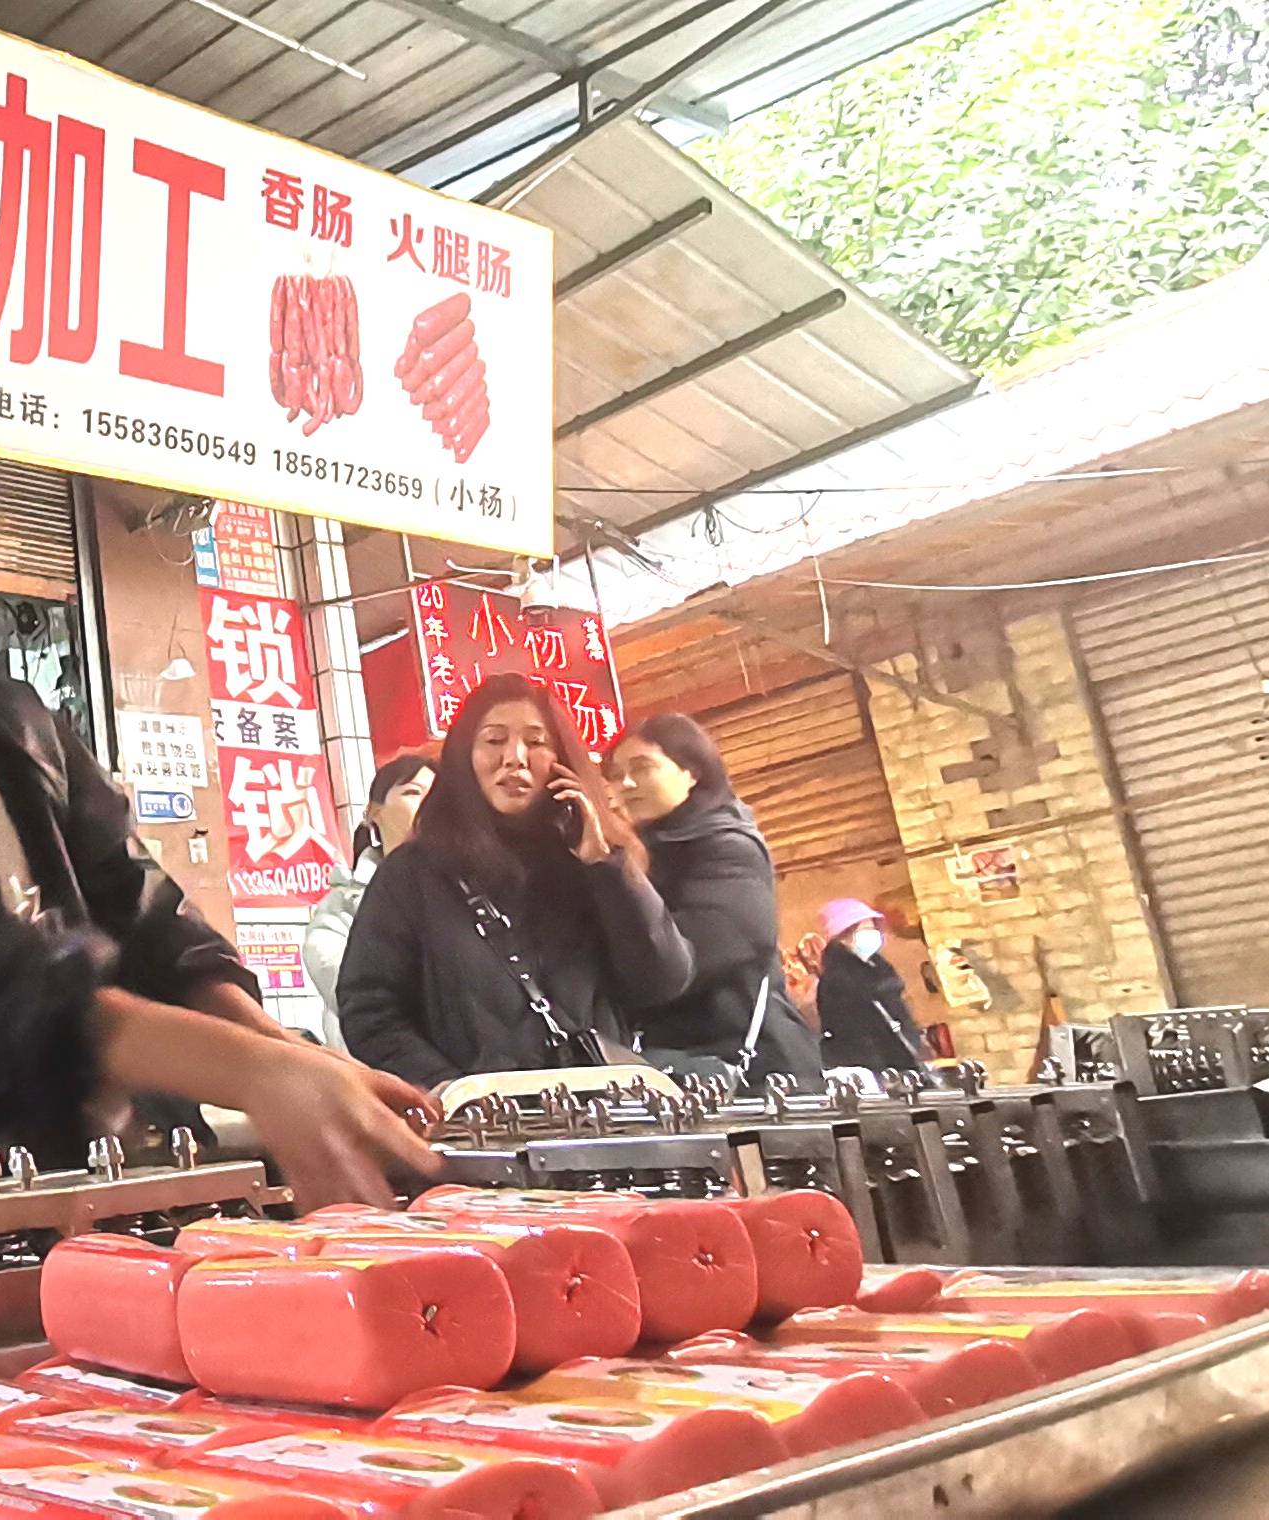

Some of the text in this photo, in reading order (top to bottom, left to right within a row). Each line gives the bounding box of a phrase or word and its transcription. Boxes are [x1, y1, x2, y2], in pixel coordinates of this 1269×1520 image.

[261, 167, 353, 248] 香肠
[387, 212, 512, 299] 火腿肠
[206, 595, 303, 709] 锁
[227, 756, 337, 865] 锁
